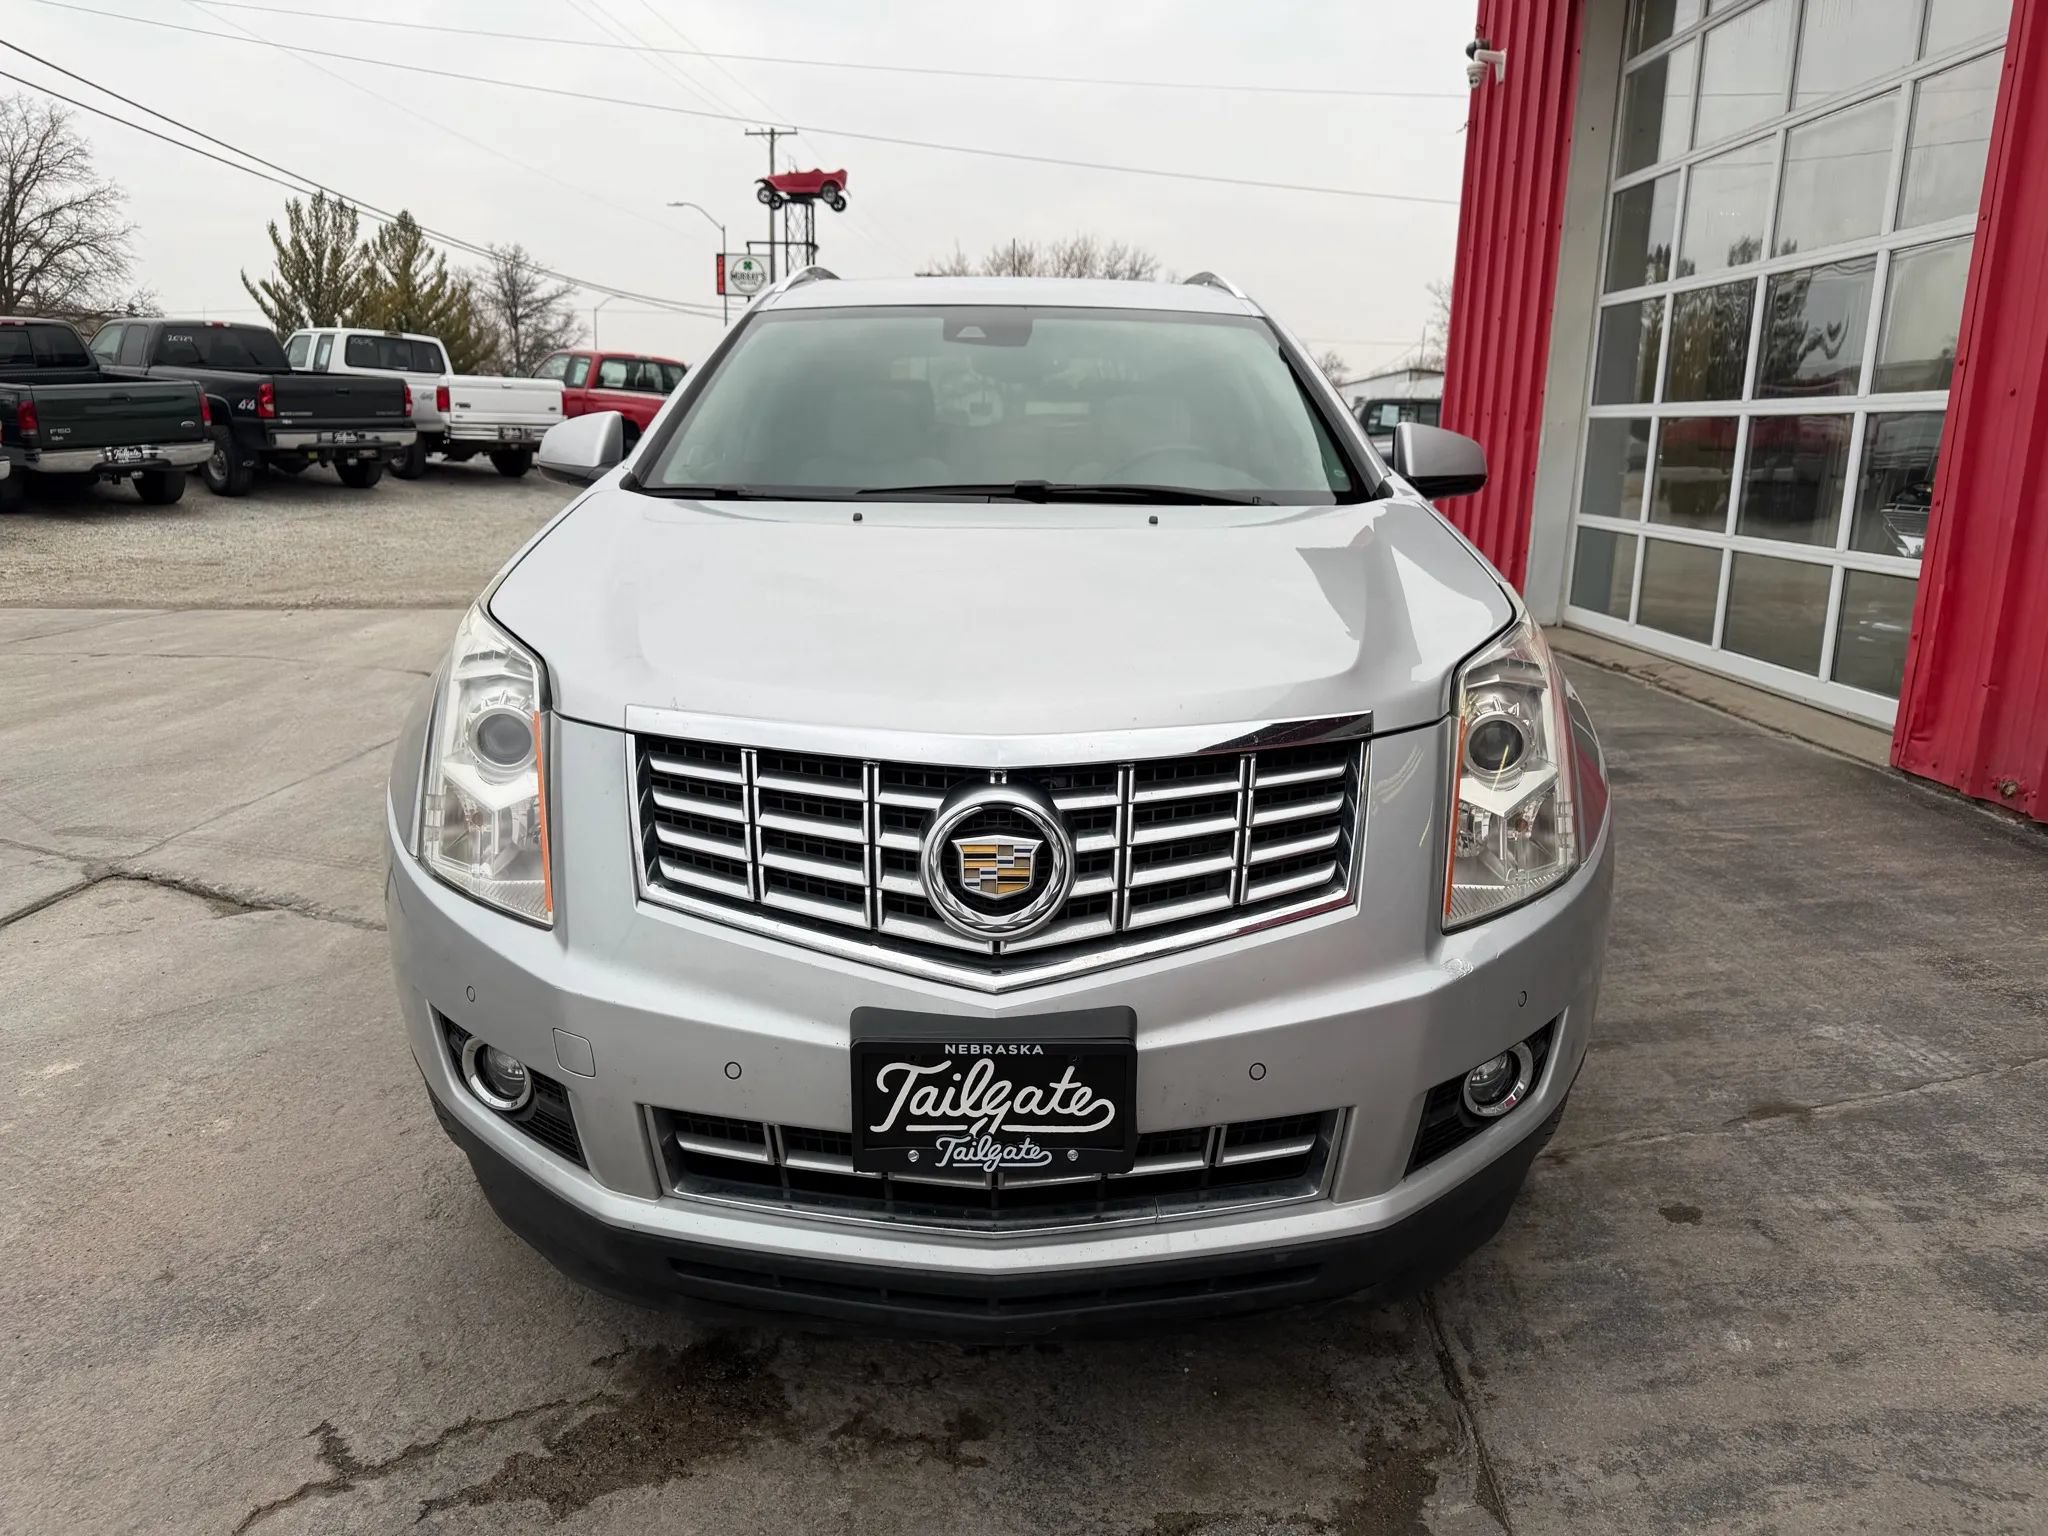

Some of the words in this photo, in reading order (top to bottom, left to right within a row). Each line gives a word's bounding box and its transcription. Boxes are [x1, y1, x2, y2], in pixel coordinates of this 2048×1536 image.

[944, 1044, 1044, 1055] NEBRASKA
[869, 1058, 1116, 1138] Tailgate
[935, 1134, 1053, 1173] Tailgate
